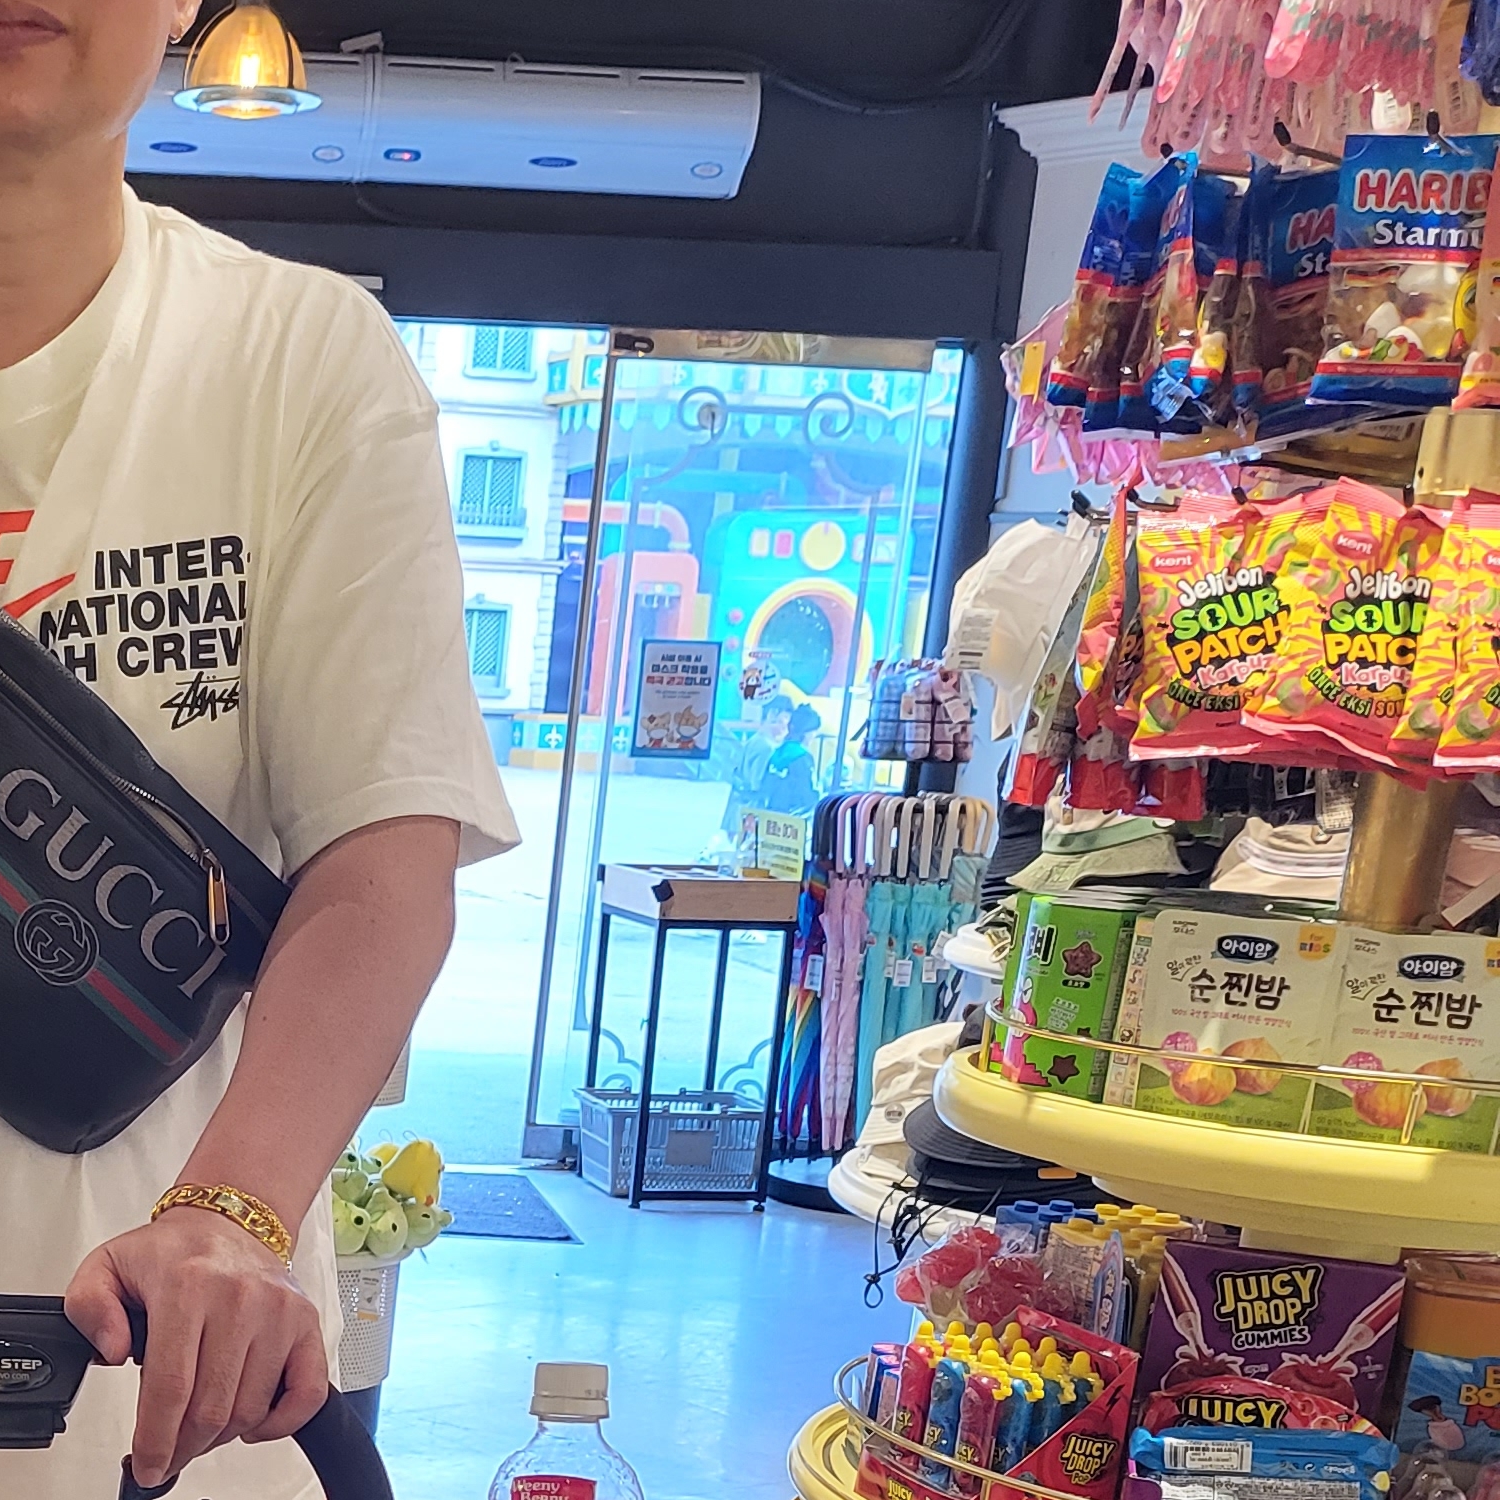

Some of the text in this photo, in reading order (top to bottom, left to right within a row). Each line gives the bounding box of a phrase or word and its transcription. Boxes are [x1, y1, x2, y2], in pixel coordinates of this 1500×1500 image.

[1355, 170, 1492, 214] HARIB
[1337, 535, 1372, 554] kent
[1155, 556, 1193, 567] kent
[1177, 566, 1263, 607] Jelibon
[1345, 568, 1431, 600] Jelibon
[1172, 588, 1279, 640] SOUR
[1172, 610, 1289, 674] PATCH
[1324, 634, 1417, 665] PATC
[1220, 1268, 1316, 1313] JUICY
[1238, 1298, 1301, 1330] DROP
[1234, 1326, 1309, 1349] GUMMIES
[0, 1358, 42, 1371] STEP
[1062, 1436, 1114, 1464] JUICY
[1067, 1454, 1100, 1474] DROP
